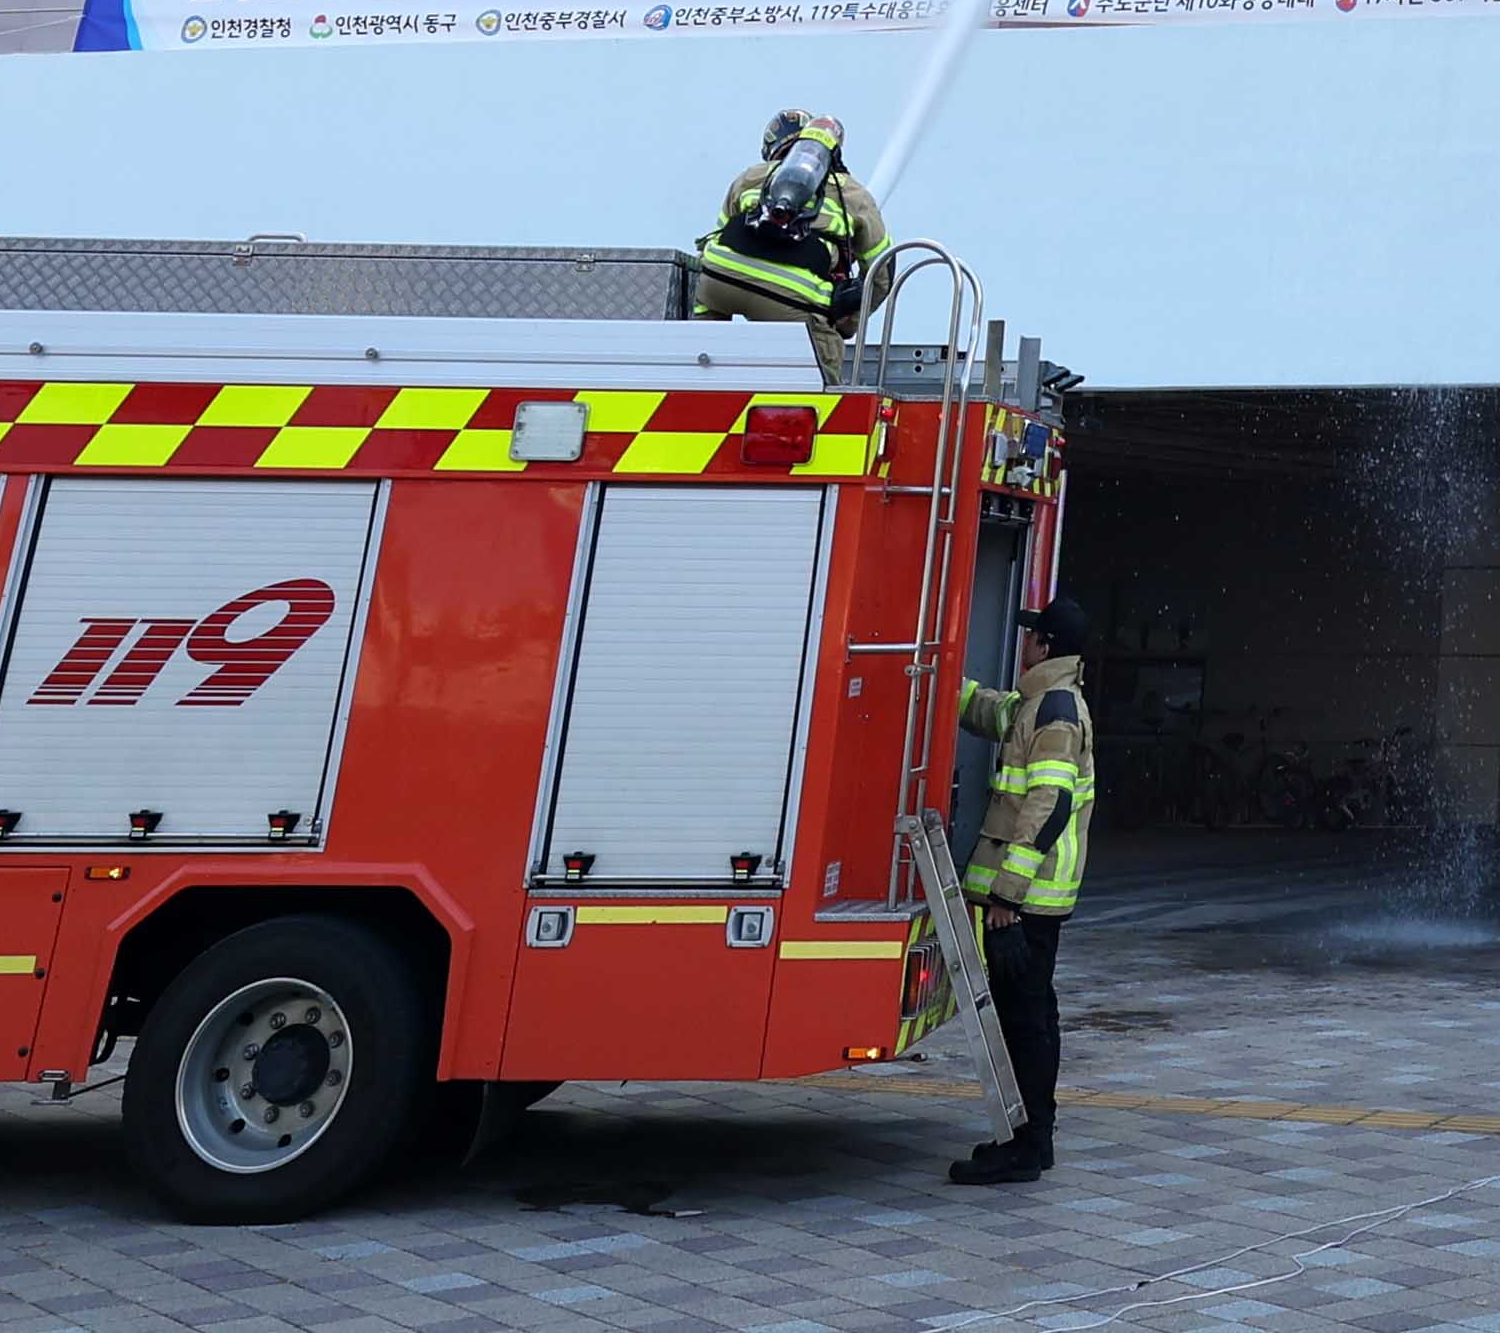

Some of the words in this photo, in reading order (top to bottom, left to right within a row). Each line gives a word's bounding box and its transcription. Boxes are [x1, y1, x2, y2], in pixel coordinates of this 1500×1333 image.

[210, 17, 292, 39] 인천경찰청
[334, 14, 419, 36] 인천광역시
[423, 13, 457, 34] 동구
[504, 9, 627, 32] 인천중부경찰서
[27, 578, 335, 706] 119
